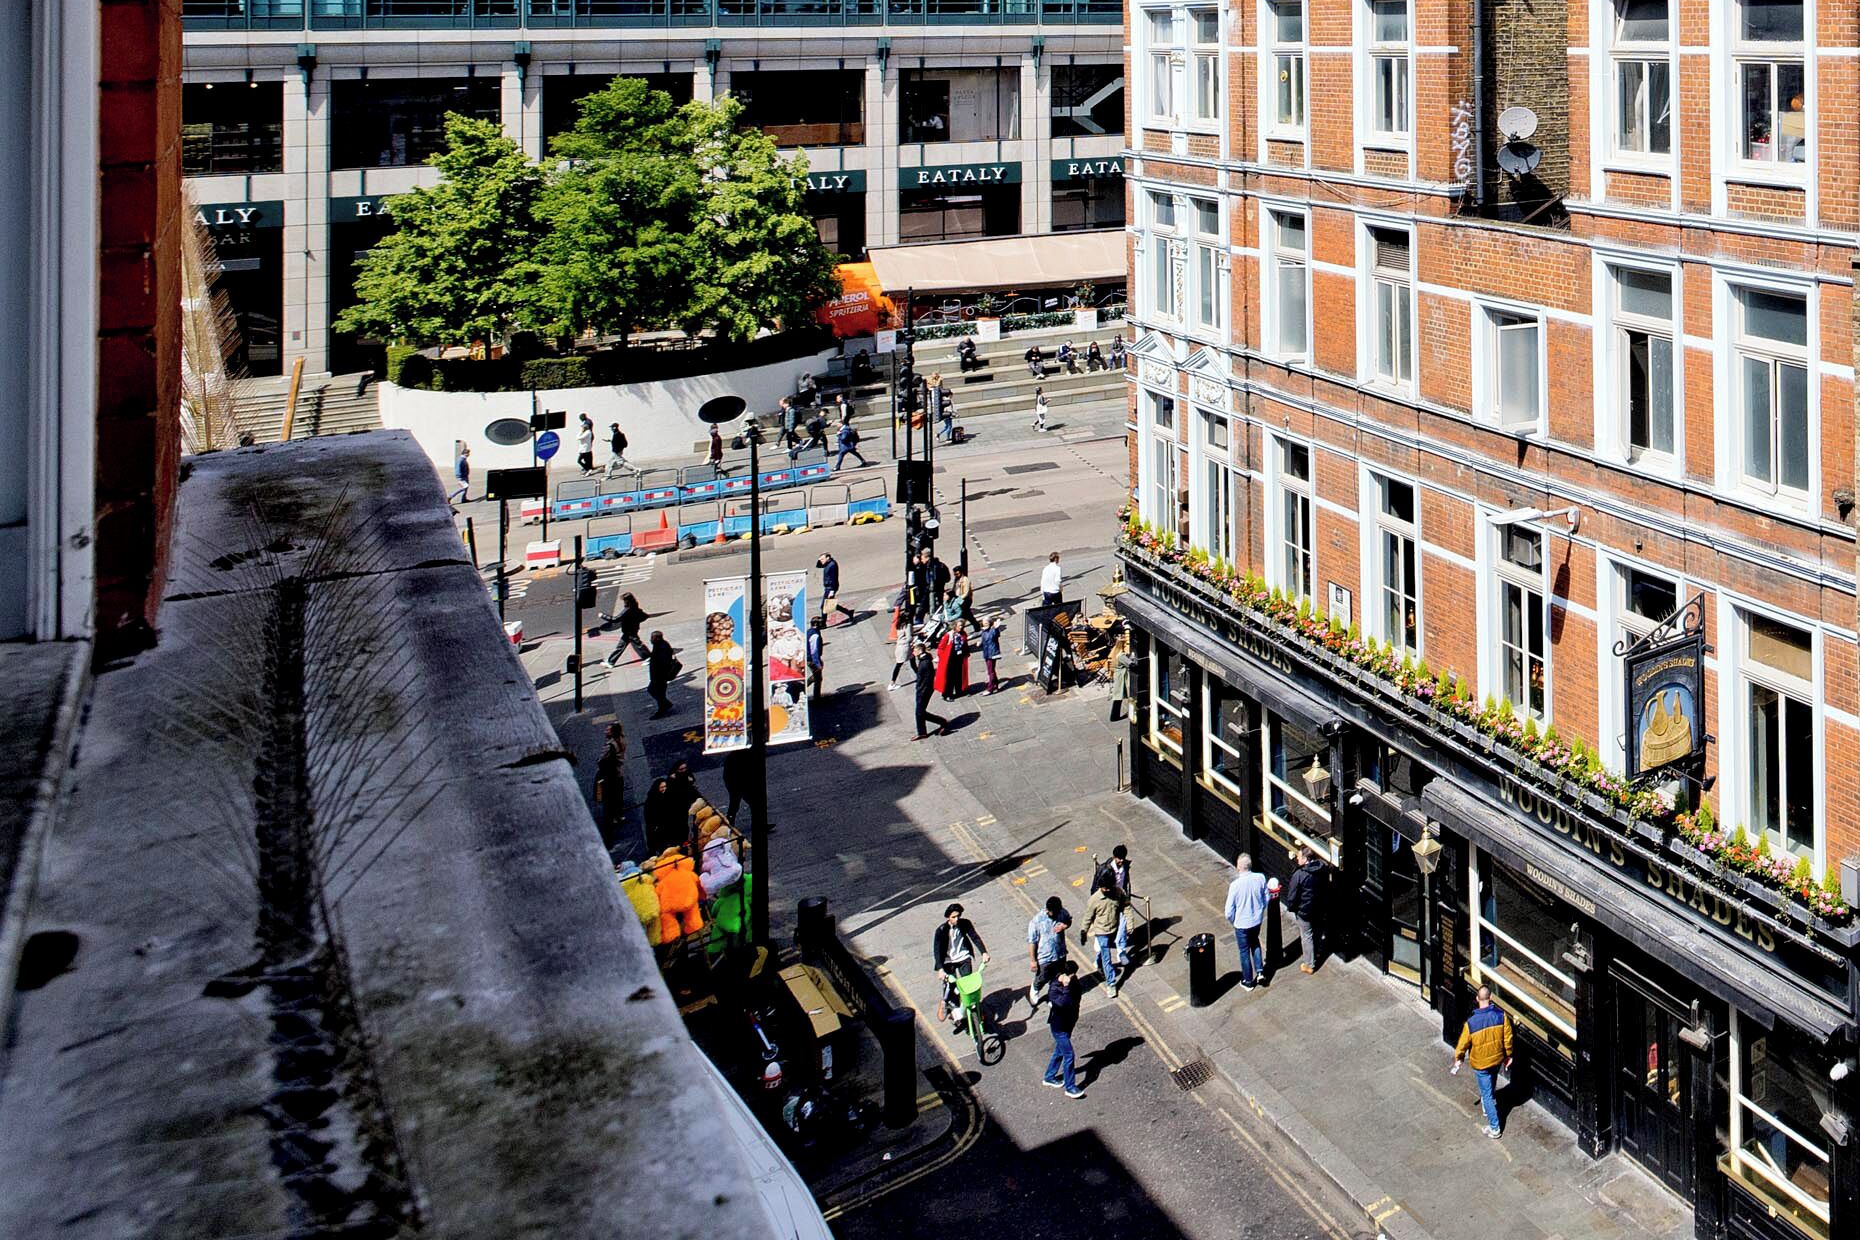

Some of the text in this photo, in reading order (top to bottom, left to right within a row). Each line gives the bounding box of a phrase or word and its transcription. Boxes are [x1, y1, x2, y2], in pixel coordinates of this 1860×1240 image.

[918, 167, 1006, 184] EATALY
[1068, 161, 1122, 176] EATA
[790, 175, 848, 190] TALY
[1228, 622, 1292, 674] SHADES
[1564, 885, 1596, 915] SHADES
[1647, 863, 1776, 953] SHADES
